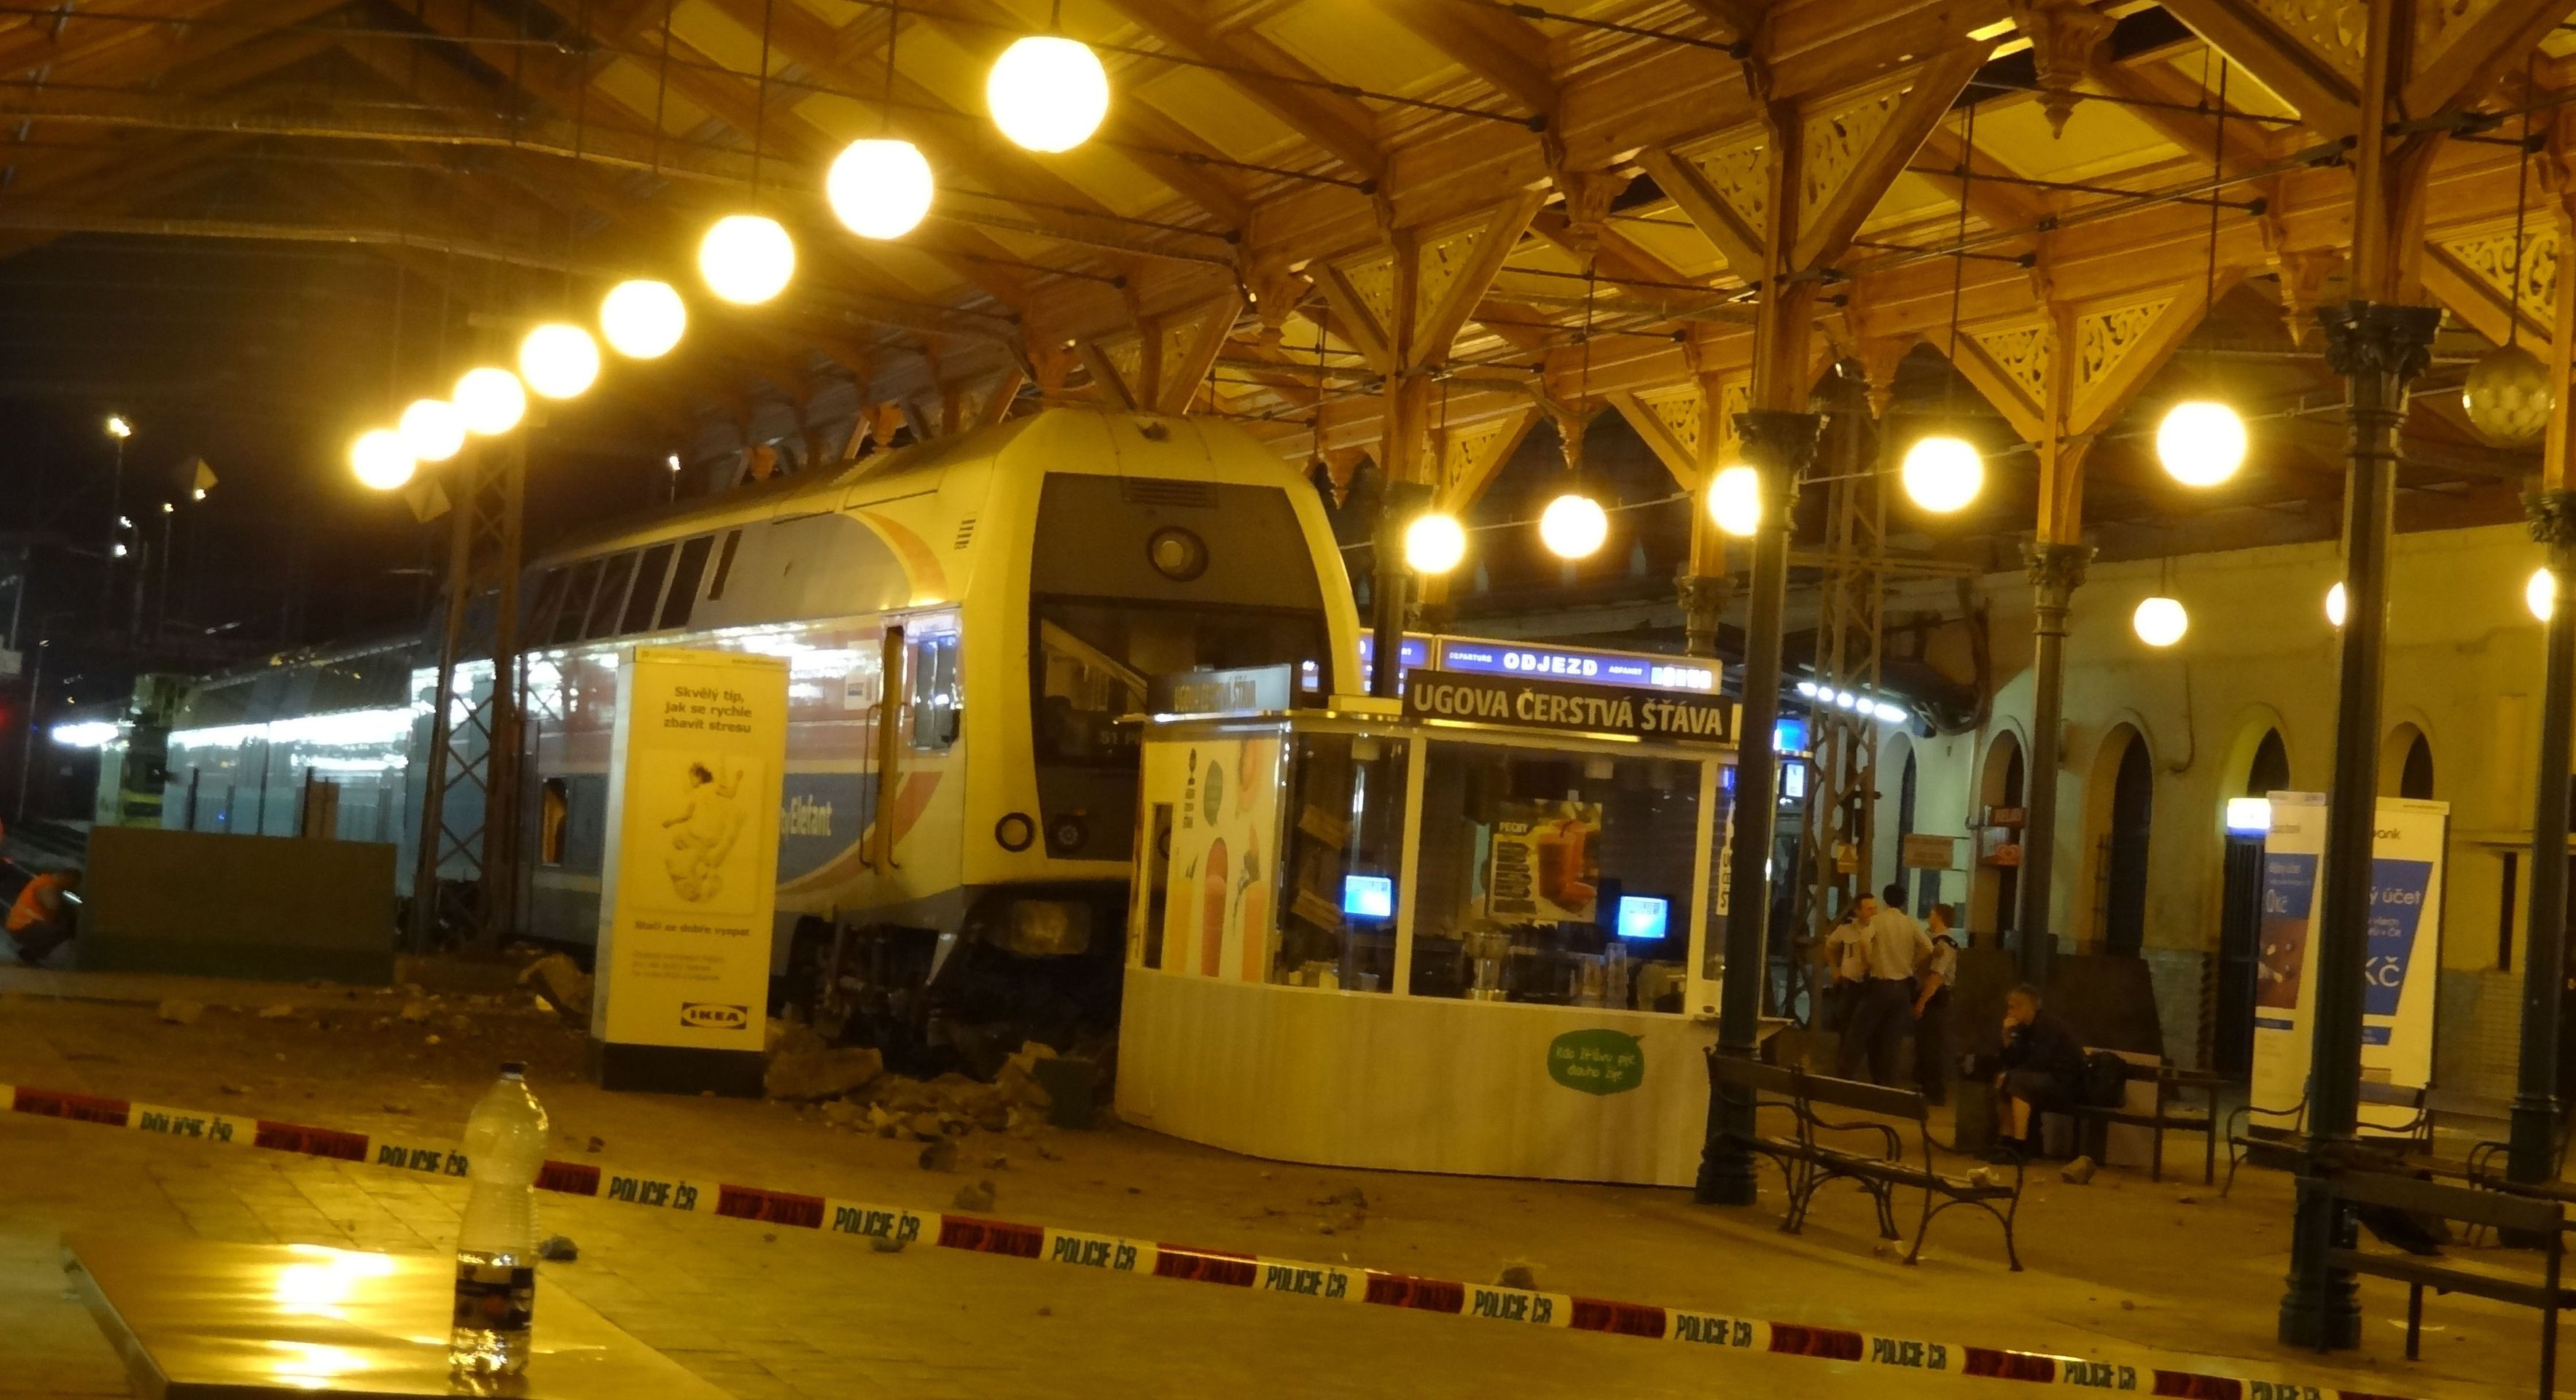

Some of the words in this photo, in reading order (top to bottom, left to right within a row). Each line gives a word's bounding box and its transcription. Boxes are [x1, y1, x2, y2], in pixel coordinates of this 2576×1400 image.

[1504, 652, 1599, 676] ODJEZD
[674, 686, 719, 701] Skvělý
[663, 716, 704, 729] zbavit
[709, 720, 752, 734] stresu
[664, 701, 686, 714] jak
[690, 705, 706, 715] se
[711, 705, 752, 718] rychle
[1413, 683, 1510, 718] UGOVA
[1516, 687, 1634, 729] ČERSTVÁ
[1641, 698, 1722, 736] ŠŤÁVA
[2382, 887, 2422, 905] účet
[690, 1008, 740, 1022] IKEA
[378, 1145, 442, 1172] POLICIE
[445, 1149, 468, 1177] ČR
[608, 1175, 671, 1208] POLICIE
[673, 1180, 698, 1211] ČR
[832, 1206, 894, 1239] POLICIE
[896, 1209, 921, 1241] ČR
[1052, 1236, 1112, 1268] POLICIE
[1112, 1240, 1137, 1272] ČR
[1265, 1265, 1322, 1296] POLICIE
[1324, 1267, 1348, 1299] ČR
[1472, 1289, 1529, 1322] POLICIE
[1674, 1314, 1729, 1346] POLICIE
[1871, 1337, 1925, 1367] POLICIE
[2063, 1361, 2115, 1388] POLICIE
